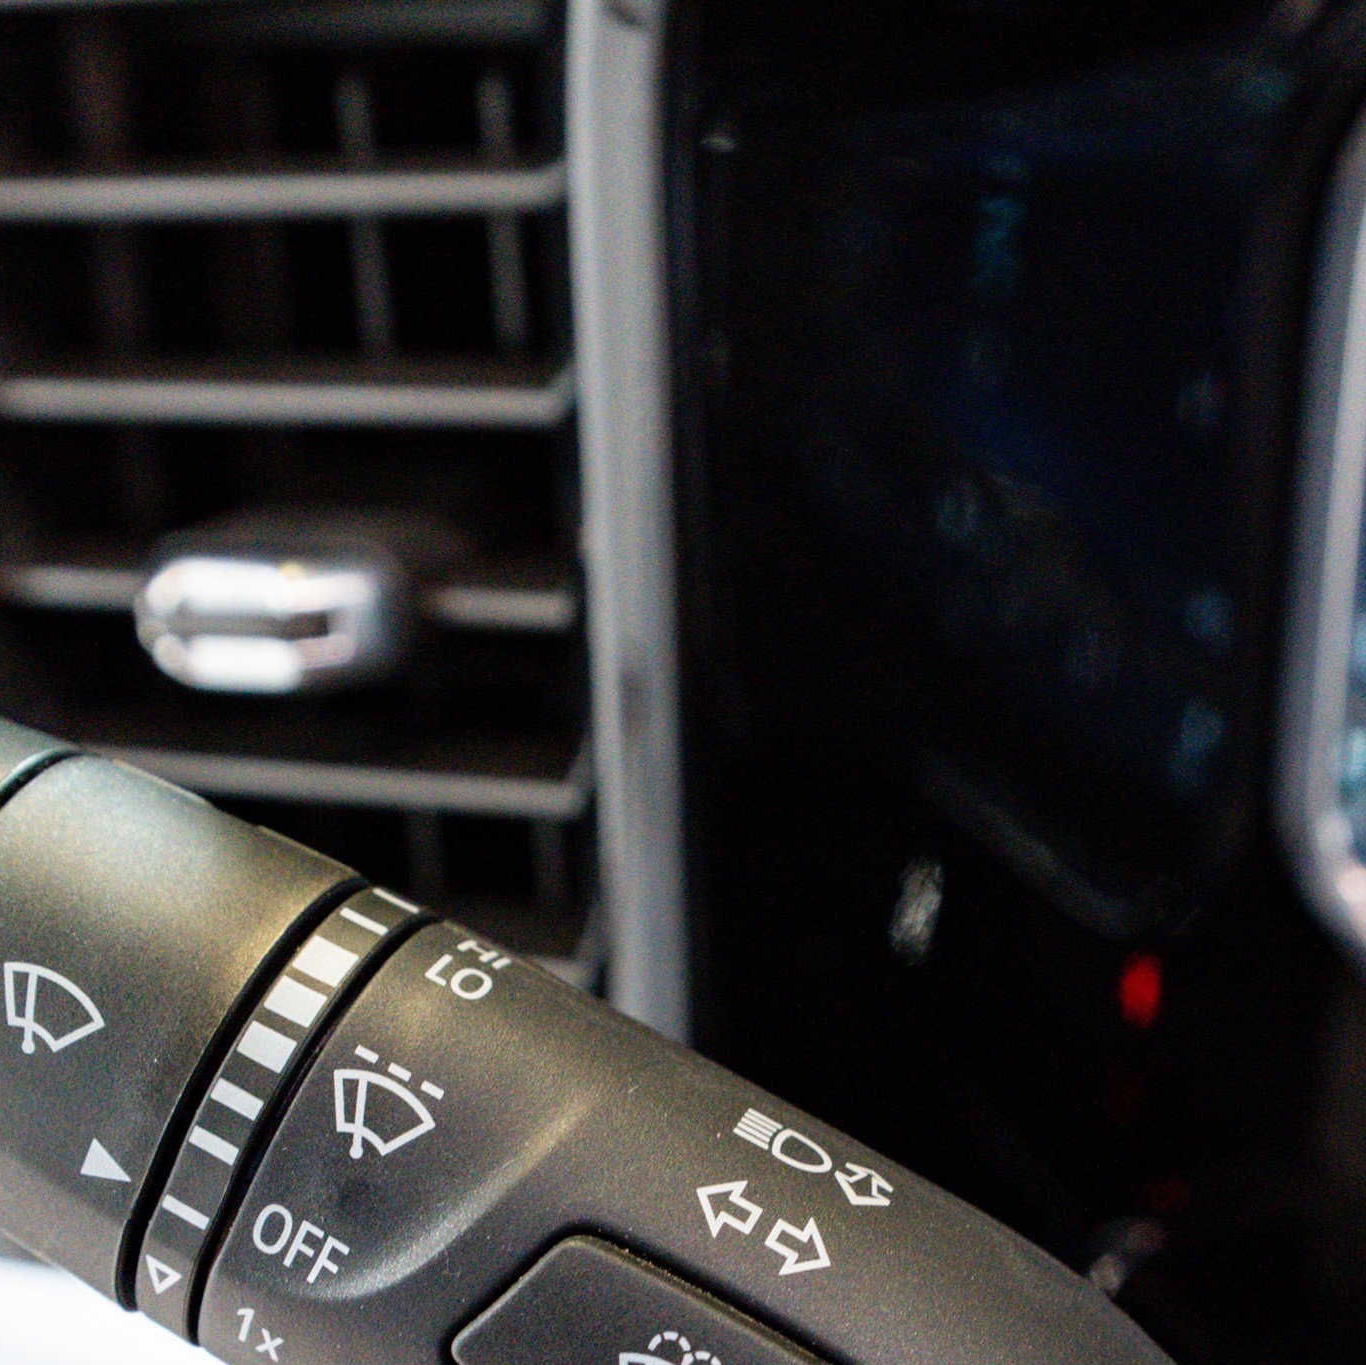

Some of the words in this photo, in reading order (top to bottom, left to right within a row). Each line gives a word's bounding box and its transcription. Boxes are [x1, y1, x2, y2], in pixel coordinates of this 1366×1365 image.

[424, 953, 493, 1000] LO
[456, 939, 512, 970] HI
[252, 1203, 351, 1284] OFF
[236, 1307, 285, 1363] 1x
